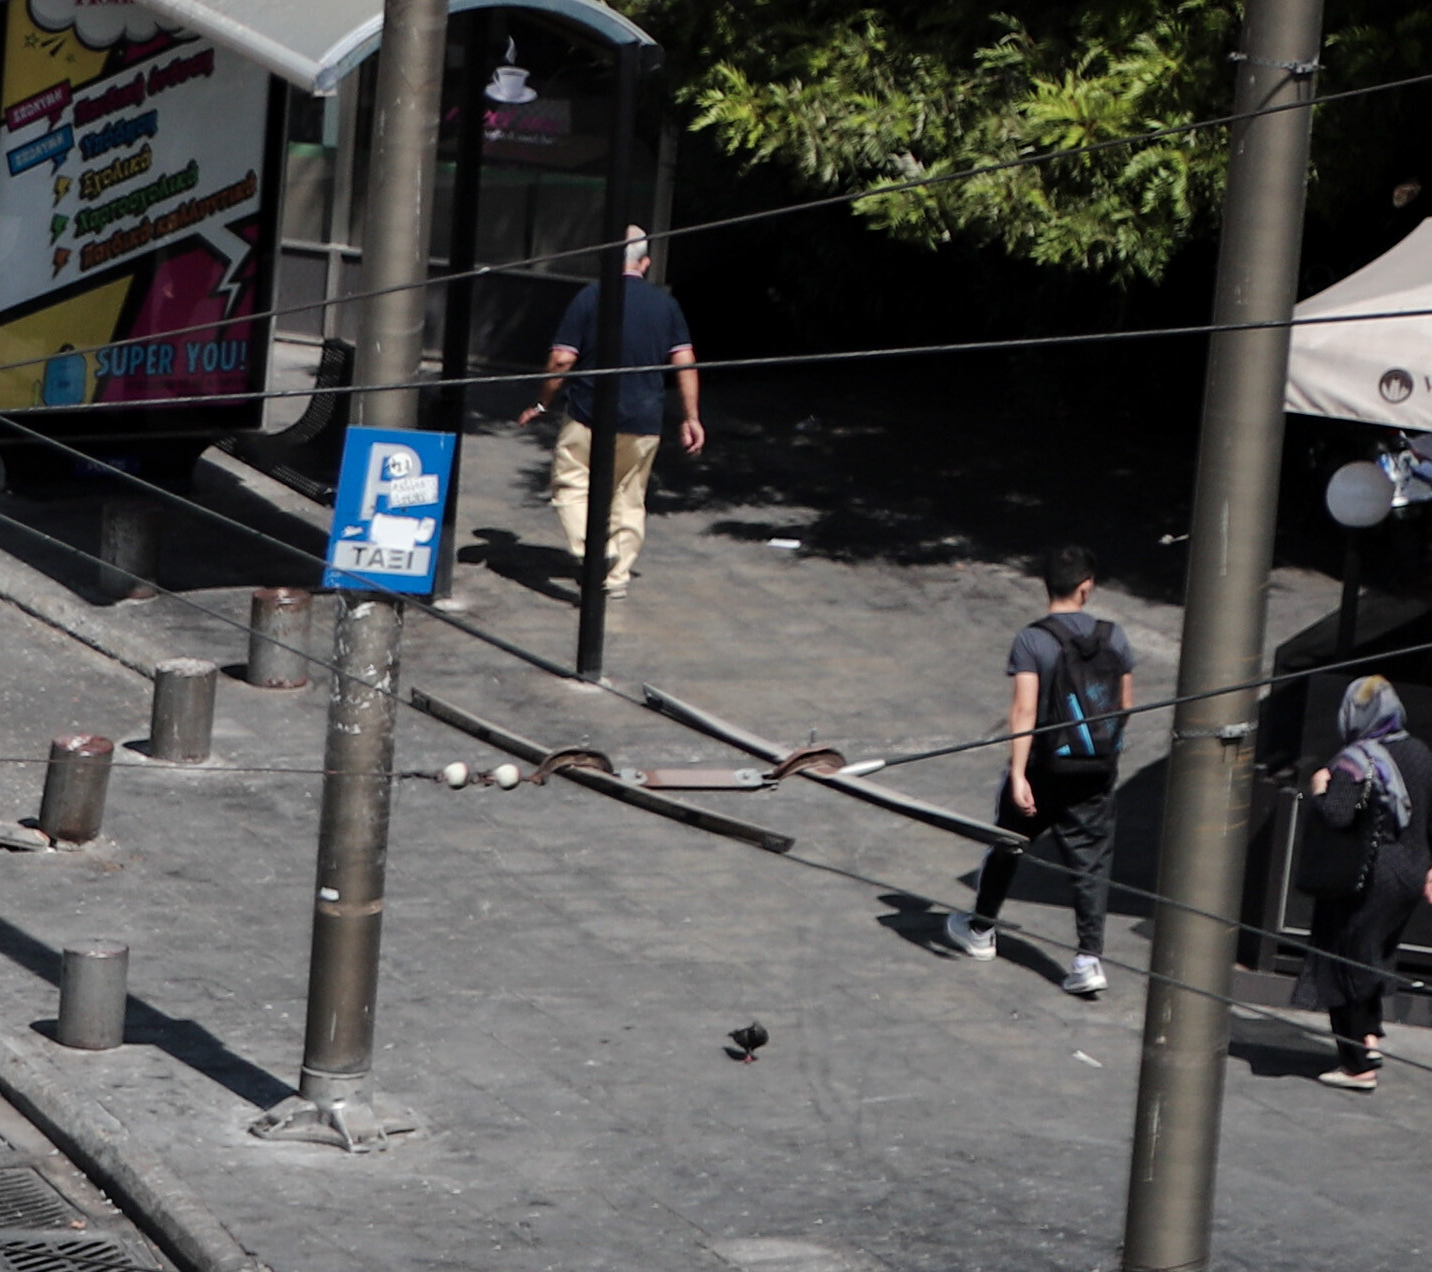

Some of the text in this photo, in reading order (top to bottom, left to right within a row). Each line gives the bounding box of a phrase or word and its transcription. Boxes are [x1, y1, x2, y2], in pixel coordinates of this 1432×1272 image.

[96, 340, 247, 377] SUPER YOU!
[359, 442, 423, 521] P
[352, 546, 415, 571] ΤΑΞΙ
